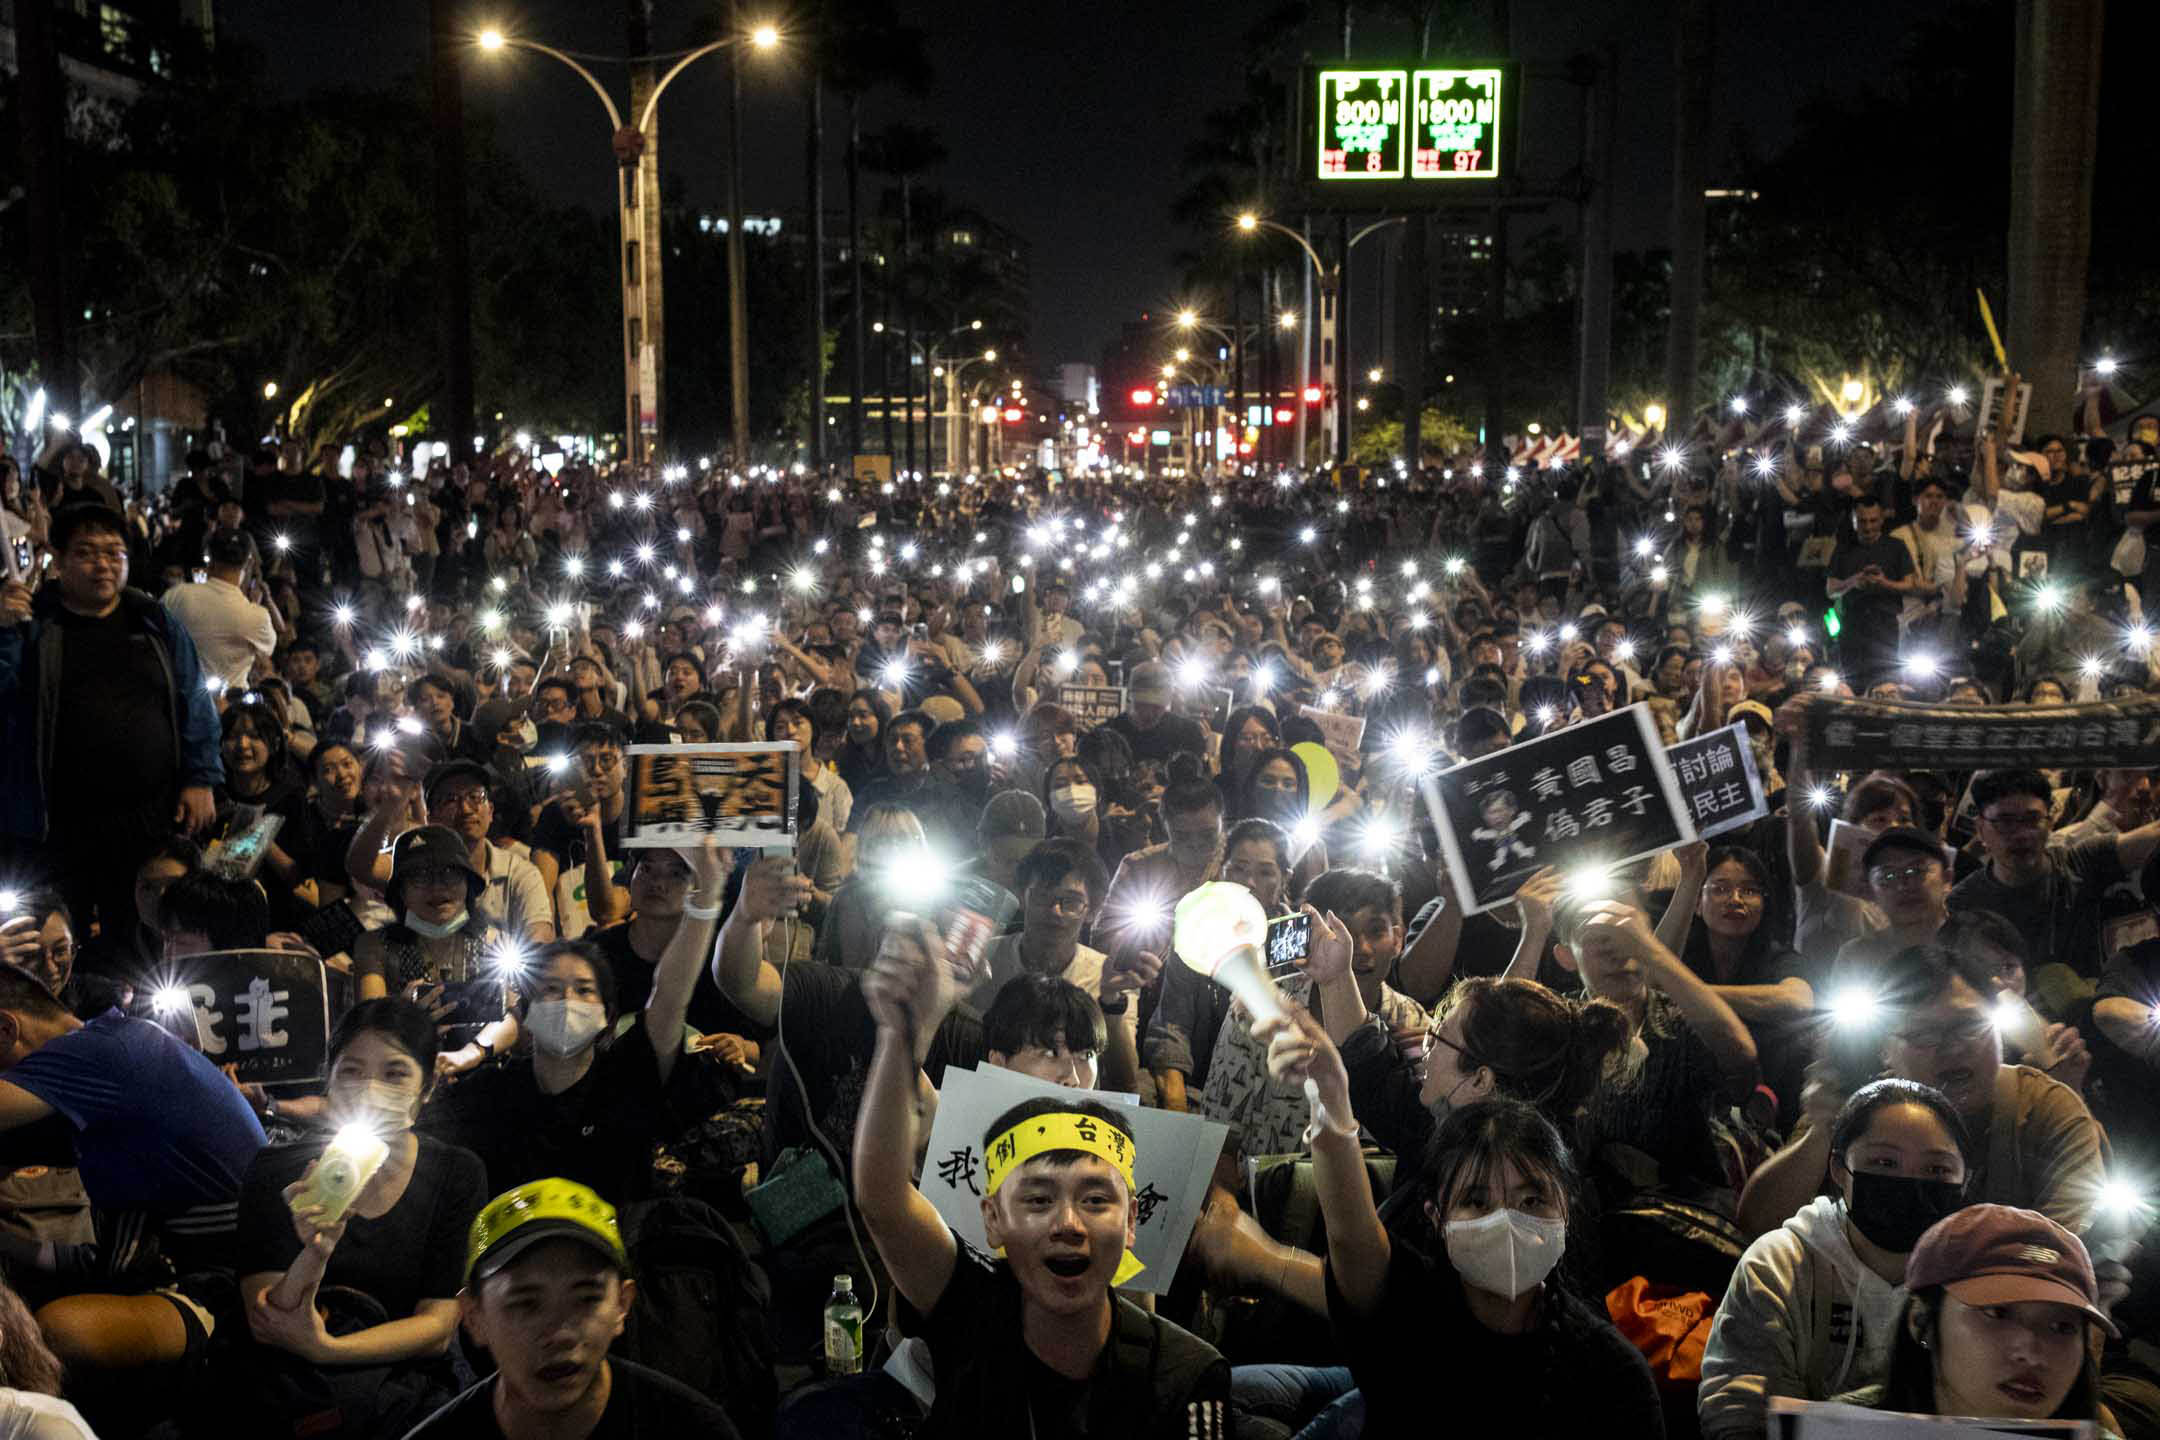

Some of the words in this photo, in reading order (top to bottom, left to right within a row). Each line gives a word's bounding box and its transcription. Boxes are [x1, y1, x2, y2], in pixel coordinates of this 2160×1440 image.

[1366, 152, 1382, 171] 8
[1453, 151, 1482, 171] 97
[1529, 744, 1637, 802] 黃國昌
[1670, 744, 1734, 785] 討論
[1544, 785, 1655, 841] 偽君子
[1687, 782, 1745, 819] 民主
[937, 1145, 981, 1196] 我
